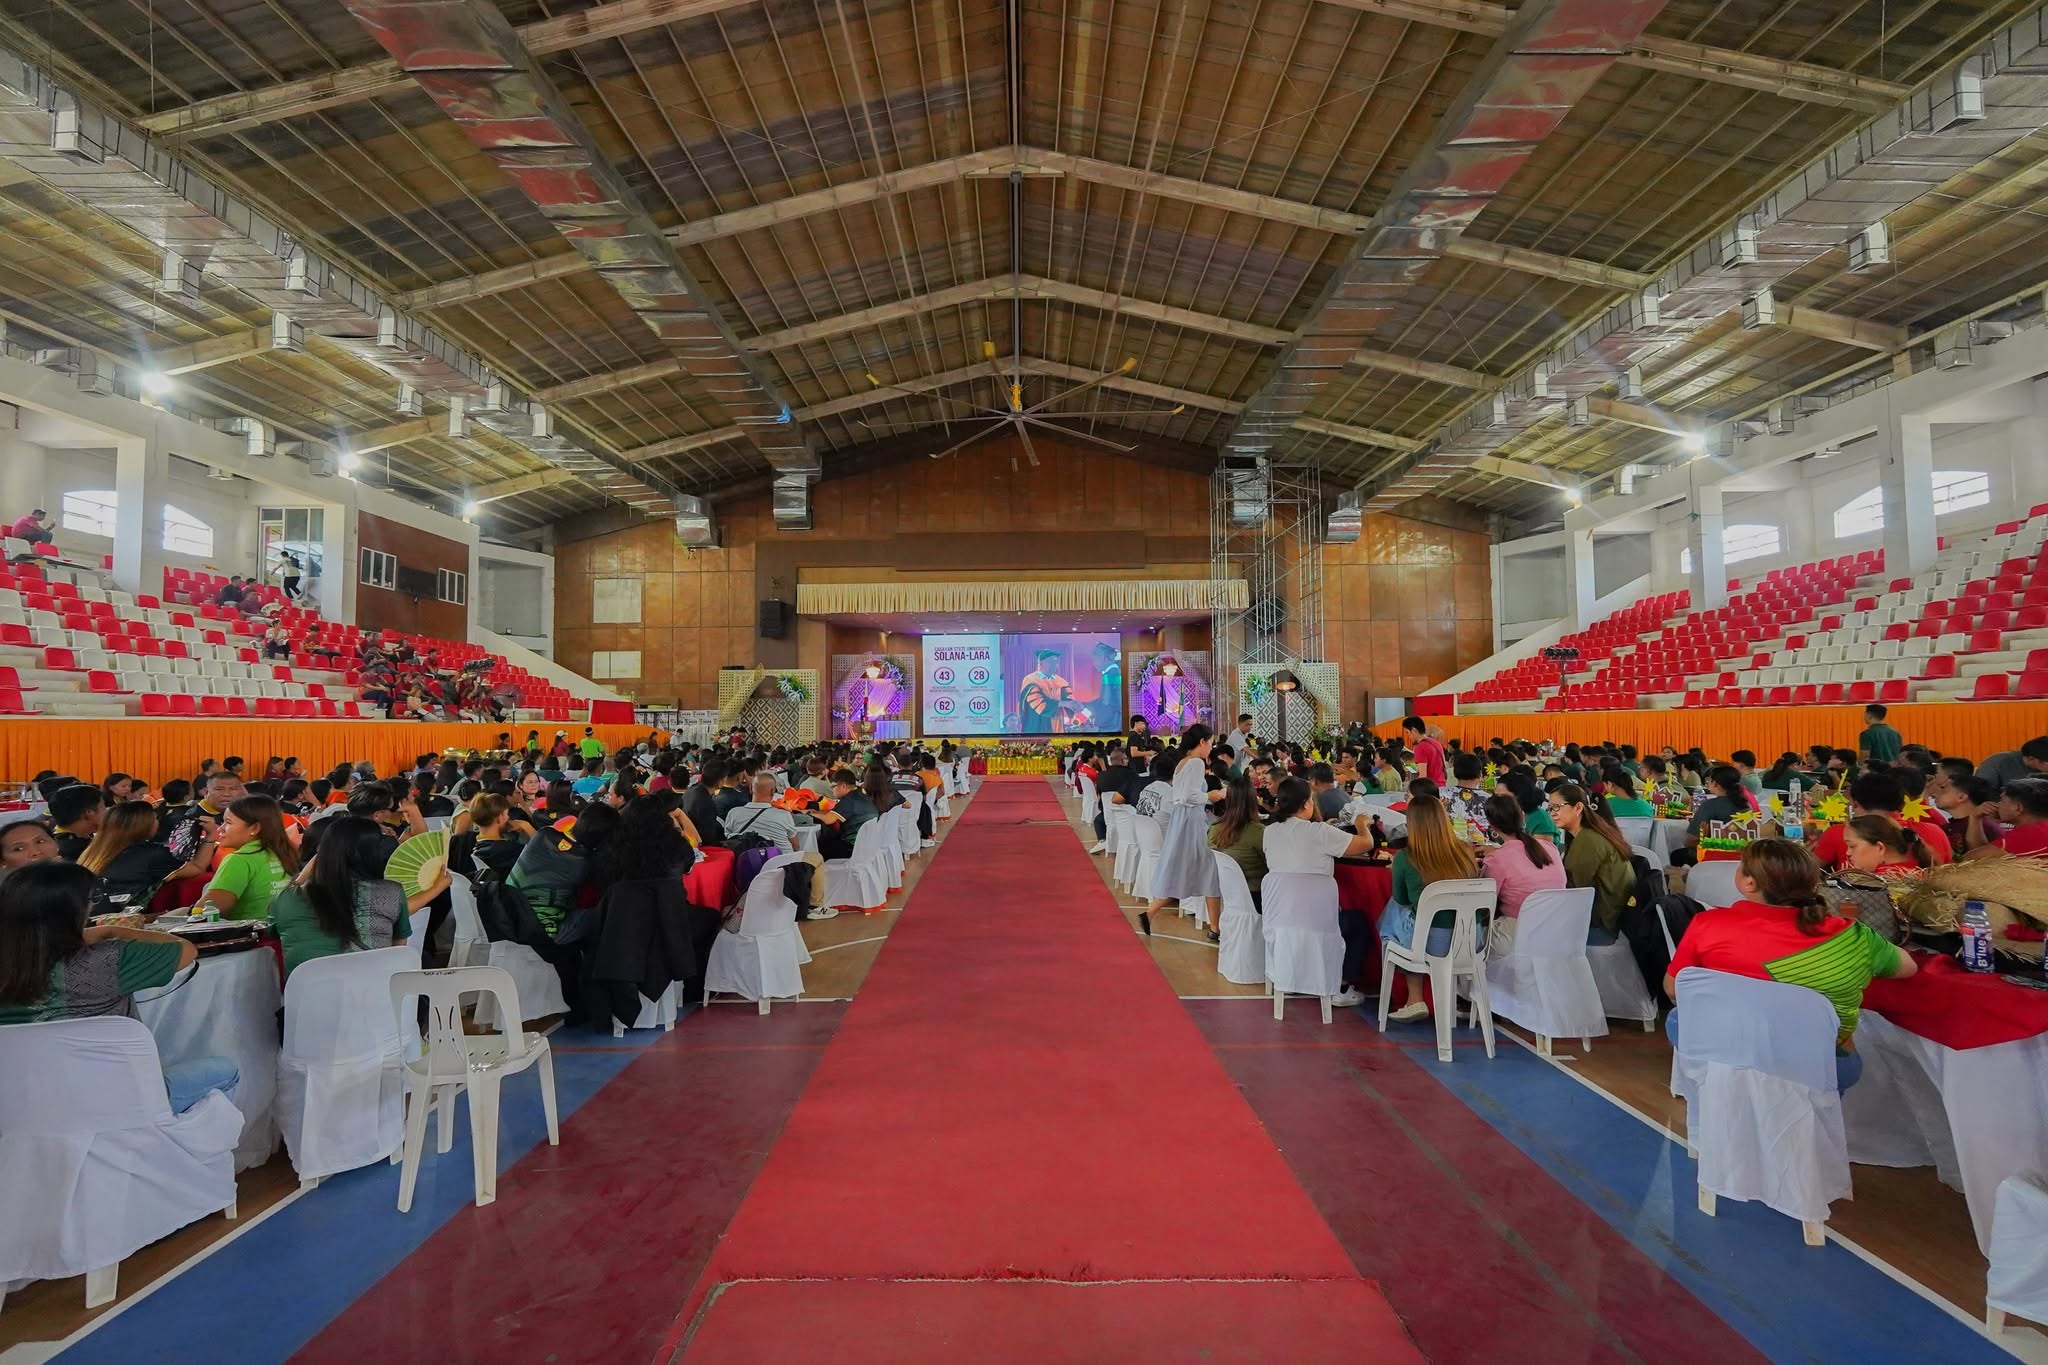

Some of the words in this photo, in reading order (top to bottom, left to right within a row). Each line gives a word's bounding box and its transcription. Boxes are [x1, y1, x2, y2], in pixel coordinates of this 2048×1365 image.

[934, 651, 990, 661] SOLANA-LARA
[939, 671, 950, 680] 43
[974, 671, 985, 680] 28
[939, 701, 950, 710] 62
[972, 701, 986, 710] 103
